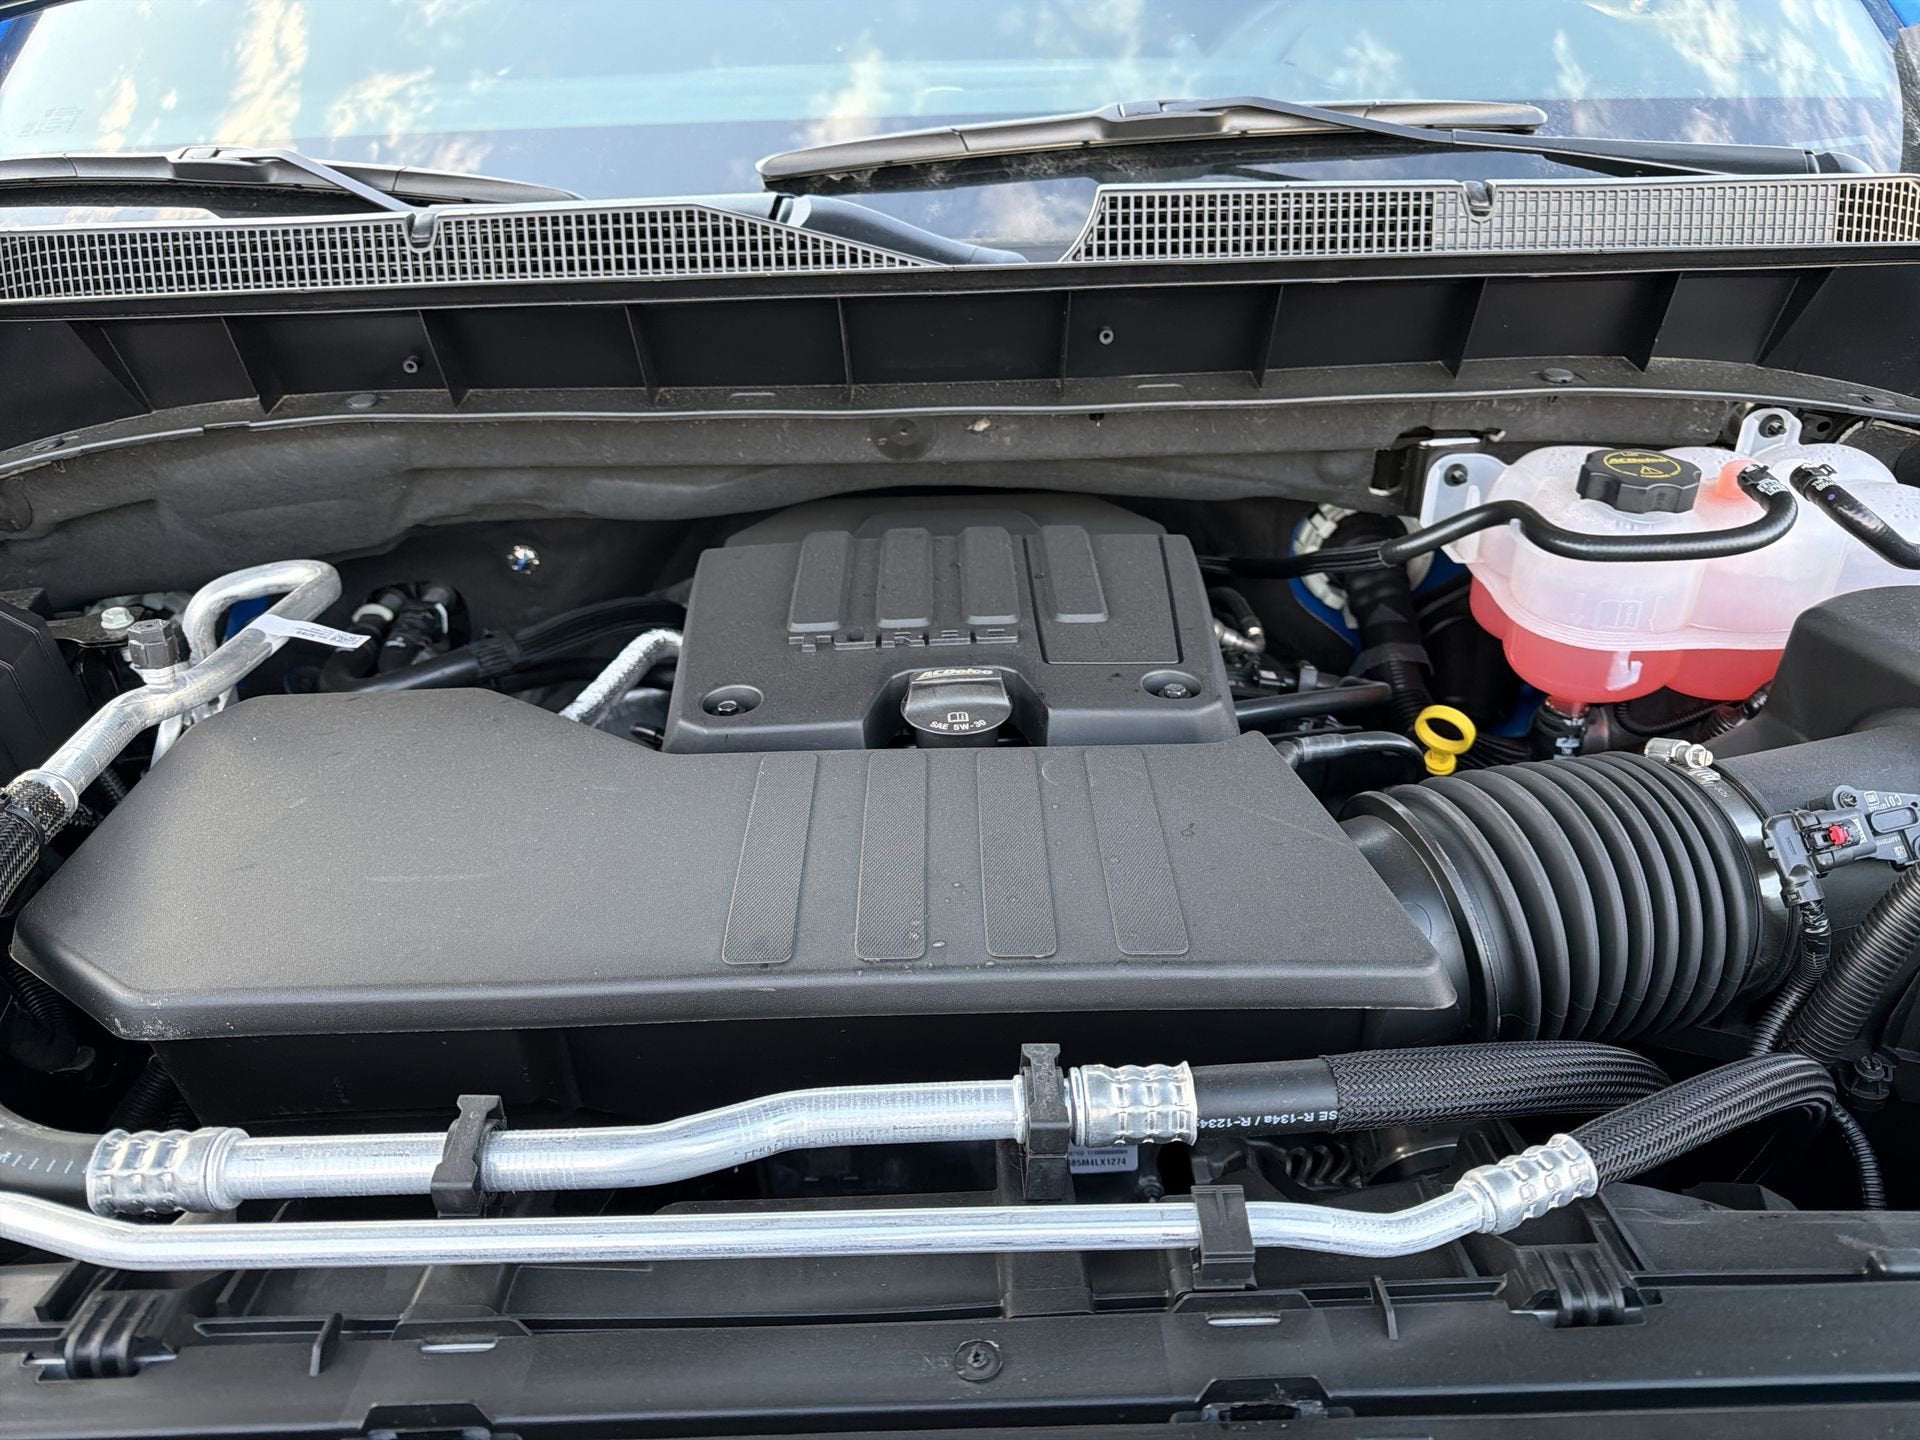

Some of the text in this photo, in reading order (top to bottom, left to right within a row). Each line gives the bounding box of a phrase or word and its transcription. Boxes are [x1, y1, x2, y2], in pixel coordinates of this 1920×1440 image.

[915, 668, 994, 681] ACDelco
[929, 719, 987, 731] SAE 5W-30
[1263, 1112, 1315, 1124] R-134a
